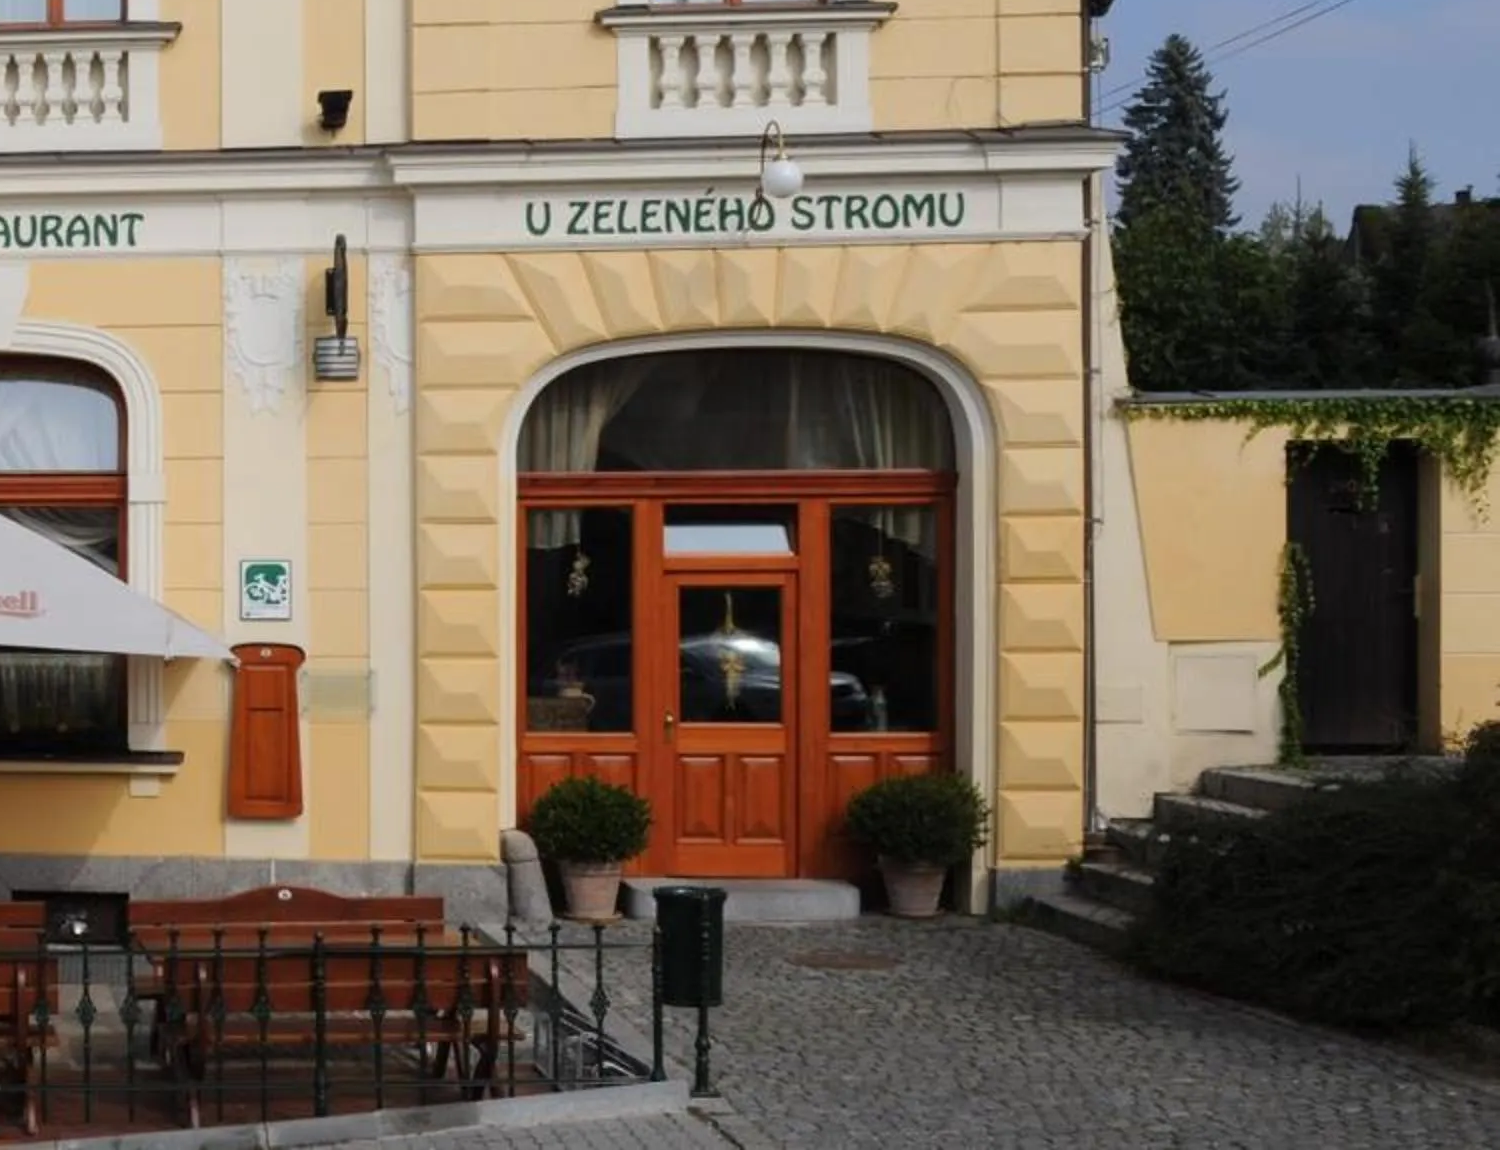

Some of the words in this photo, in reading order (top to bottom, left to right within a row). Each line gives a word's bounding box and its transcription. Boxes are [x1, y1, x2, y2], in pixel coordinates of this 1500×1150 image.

[525, 201, 551, 236] U
[566, 187, 775, 236] ZELENÉHO
[790, 192, 966, 231] STROMU
